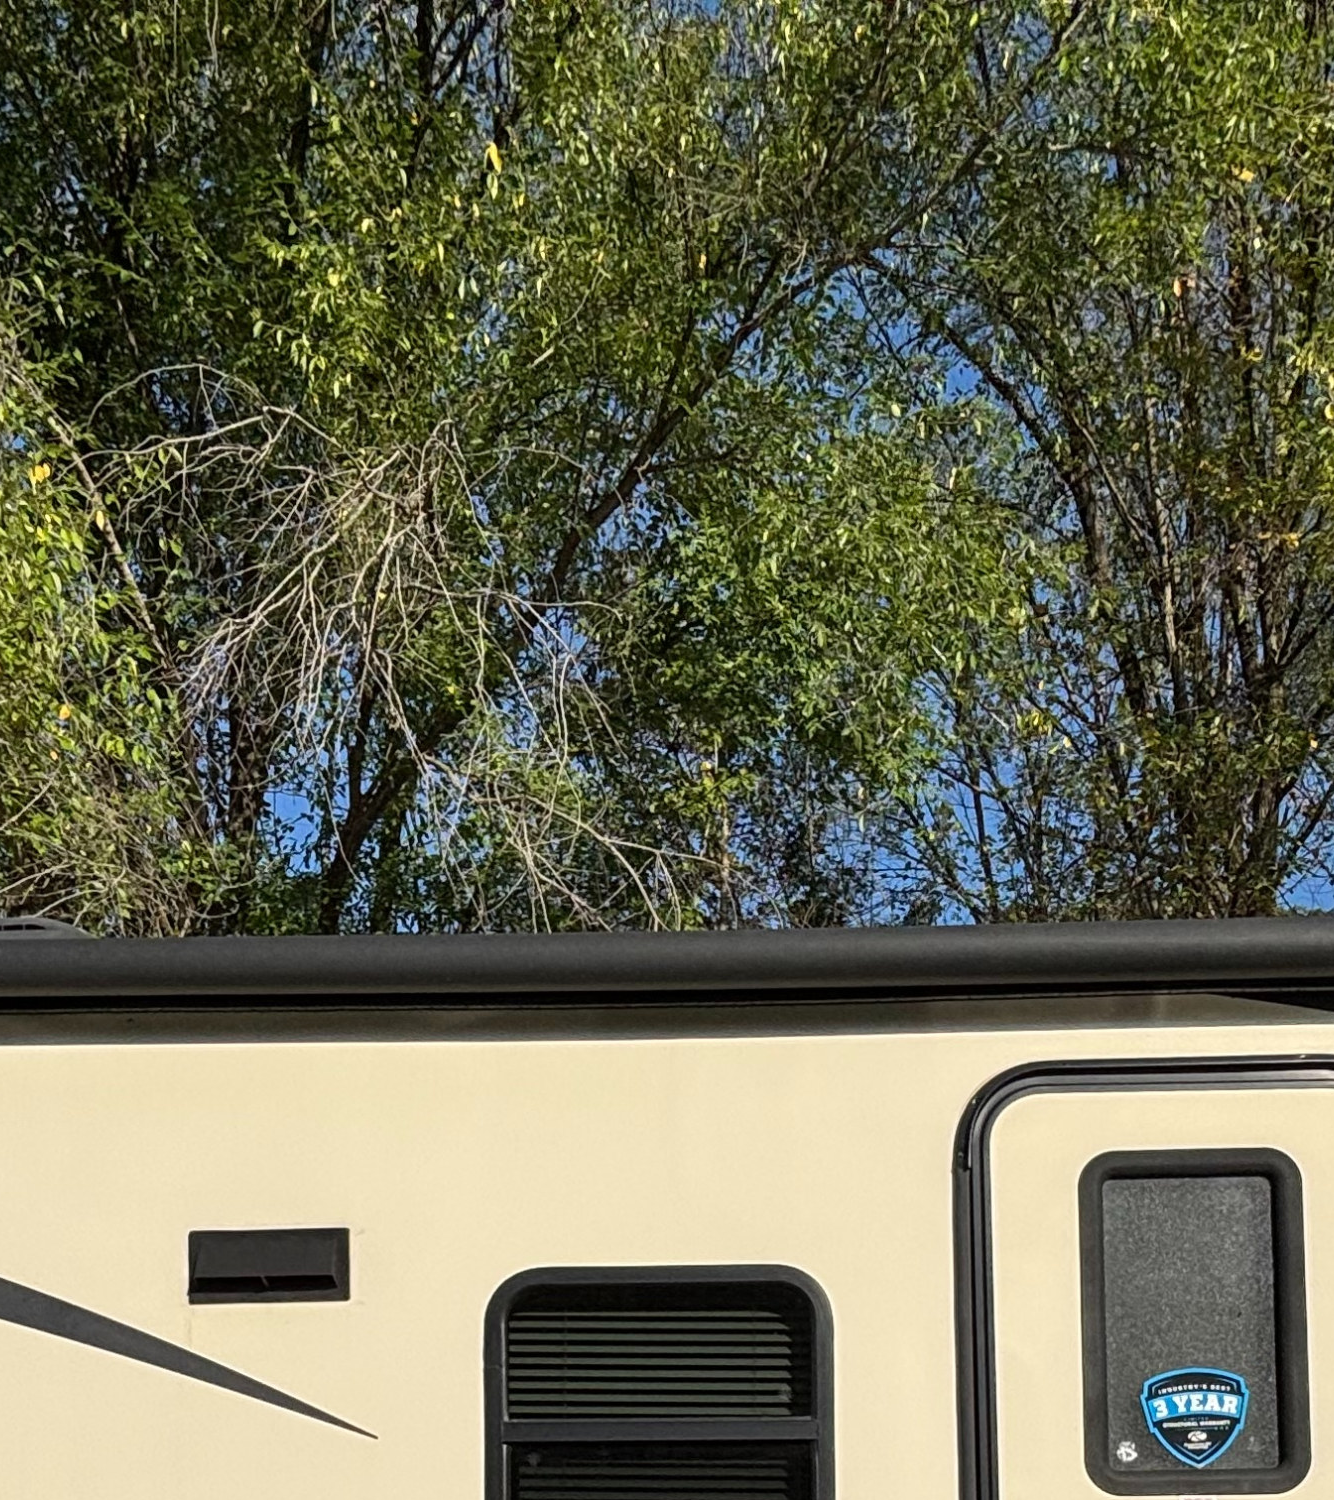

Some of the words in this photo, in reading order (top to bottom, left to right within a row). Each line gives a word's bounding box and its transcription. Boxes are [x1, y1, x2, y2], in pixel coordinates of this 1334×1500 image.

[1158, 1384, 1208, 1395] INDUSTRY'S
[1153, 1400, 1168, 1418] 3
[1172, 1394, 1237, 1414] YEAR
